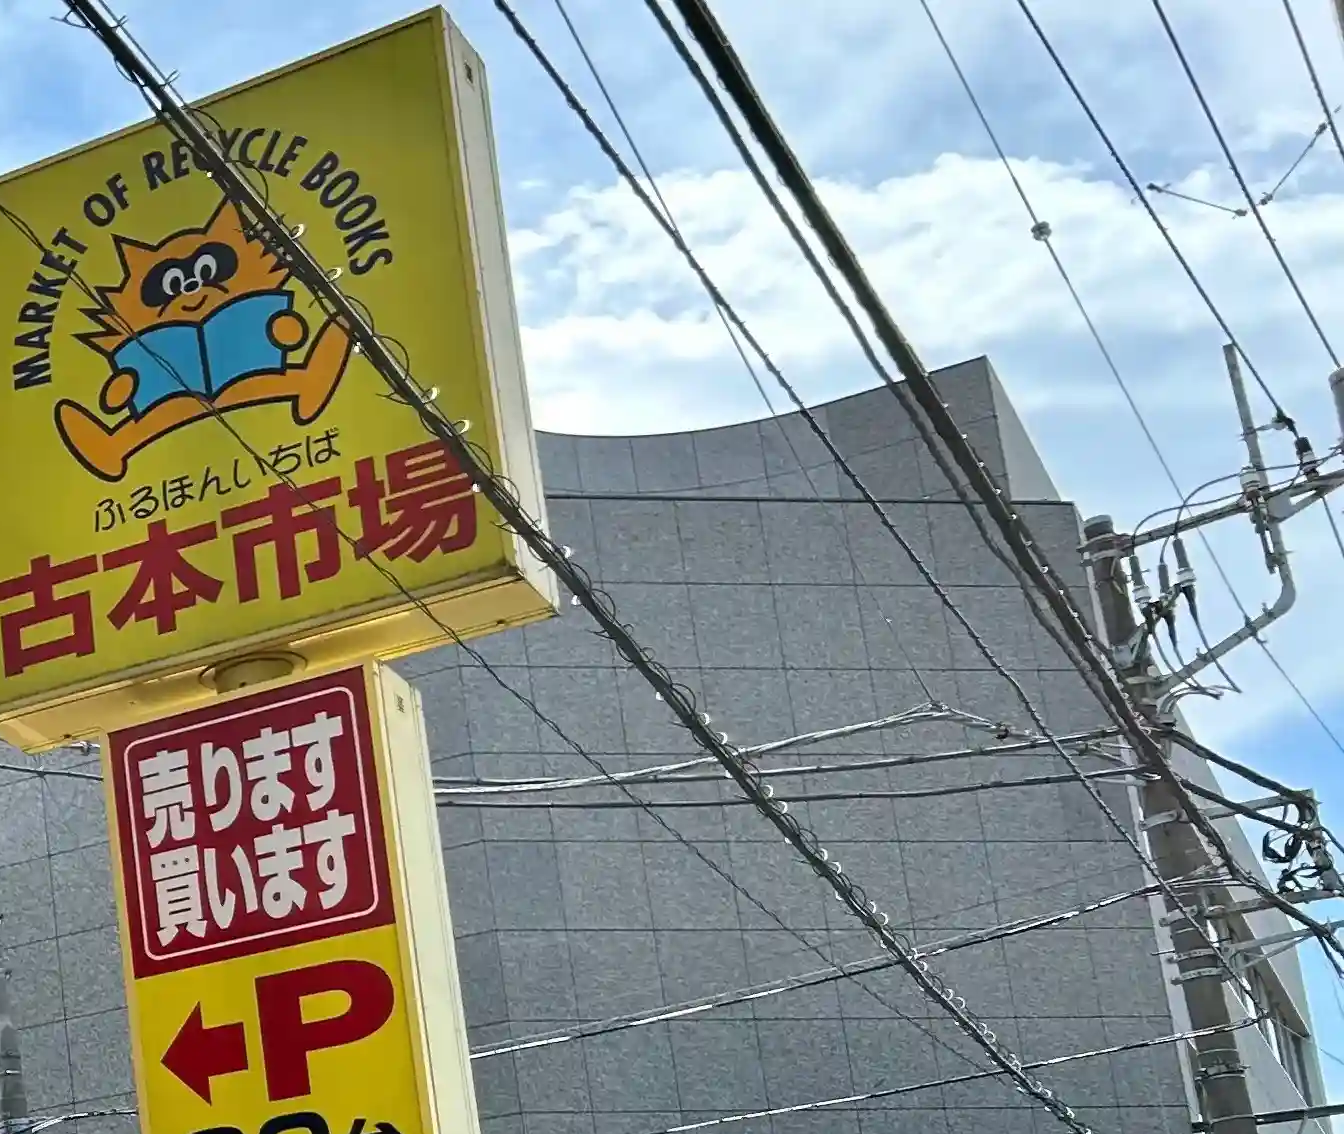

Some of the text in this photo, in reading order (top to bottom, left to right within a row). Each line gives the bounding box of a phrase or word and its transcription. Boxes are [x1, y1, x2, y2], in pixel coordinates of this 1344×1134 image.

[12, 226, 88, 391] MARKET
[83, 173, 128, 228] OF
[299, 152, 393, 276] BOOKS
[93, 428, 341, 534] ふるほんいちば
[138, 710, 344, 850] 売ります
[150, 808, 356, 948] 買います
[254, 959, 395, 1103] P
